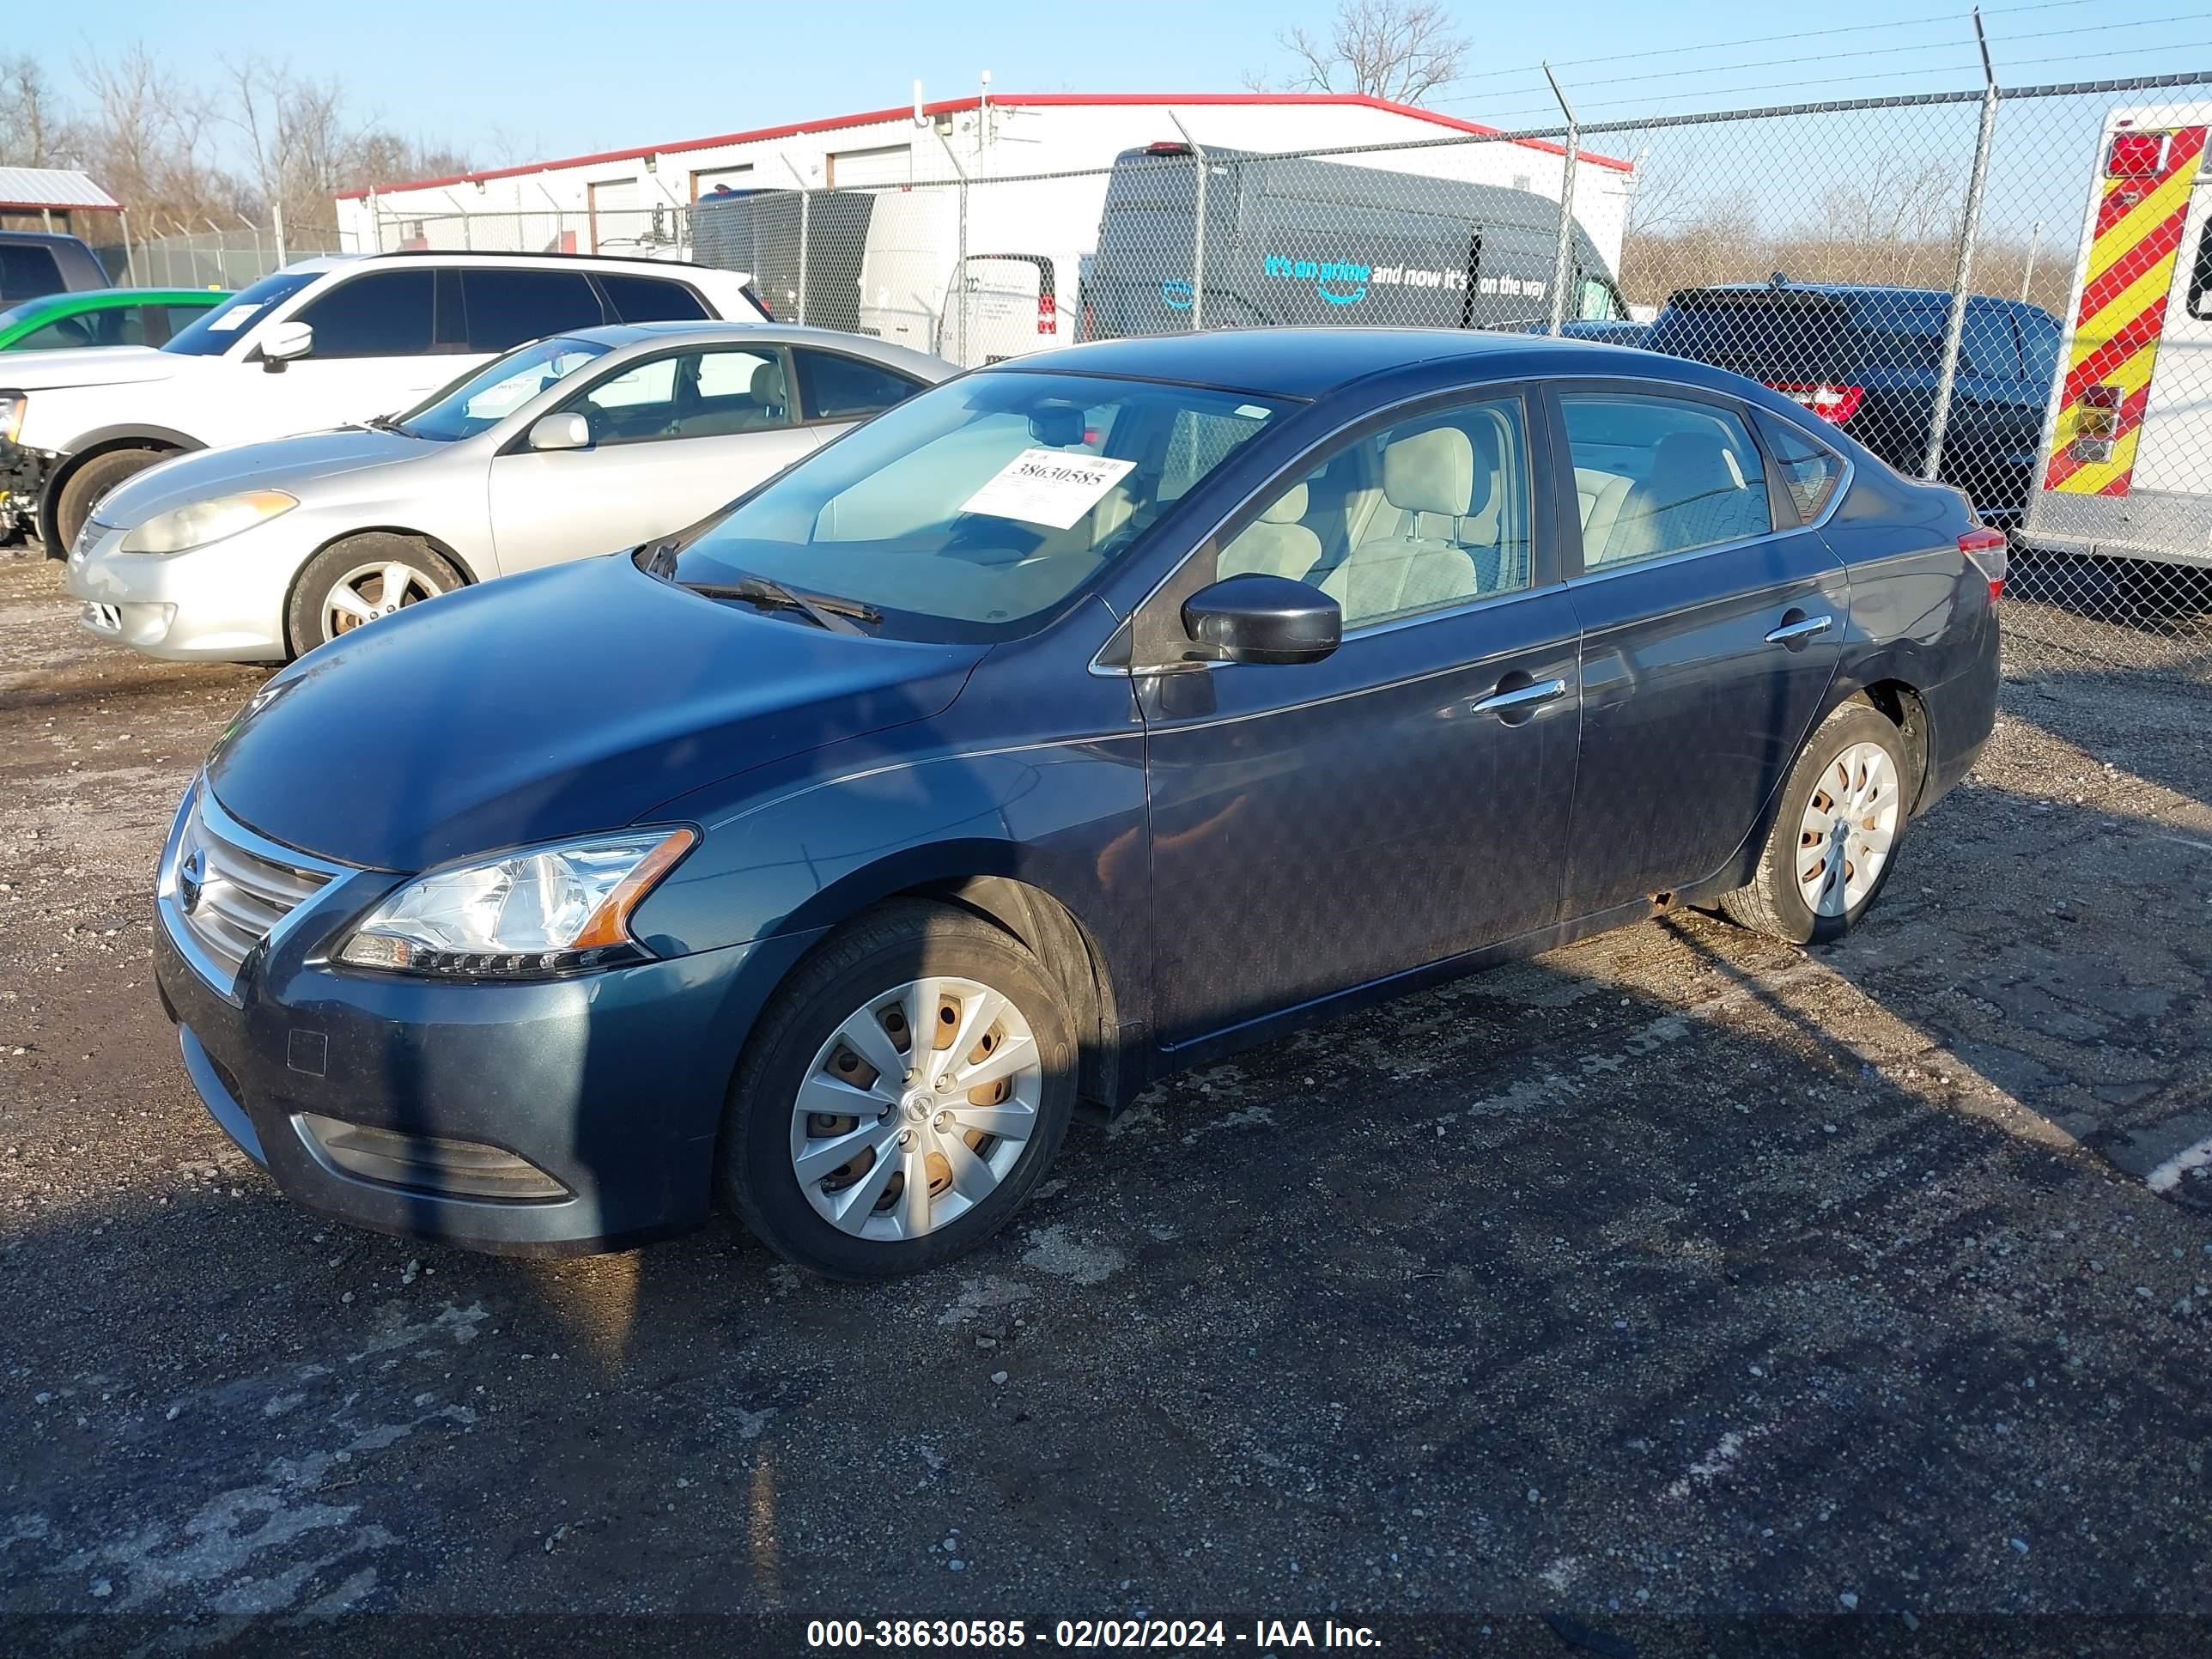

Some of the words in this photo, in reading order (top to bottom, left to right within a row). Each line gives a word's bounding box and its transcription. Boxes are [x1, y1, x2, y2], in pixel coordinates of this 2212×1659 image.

[1265, 254, 1292, 277] It's
[1295, 260, 1317, 279] on
[1319, 257, 1370, 285] prime
[1373, 264, 1403, 284] and
[1404, 269, 1442, 288] now
[1443, 266, 1468, 290] it's
[1480, 276, 1498, 295] on
[1499, 274, 1520, 295] the
[1522, 280, 1547, 301] way
[1012, 463, 1107, 486] 38630585
